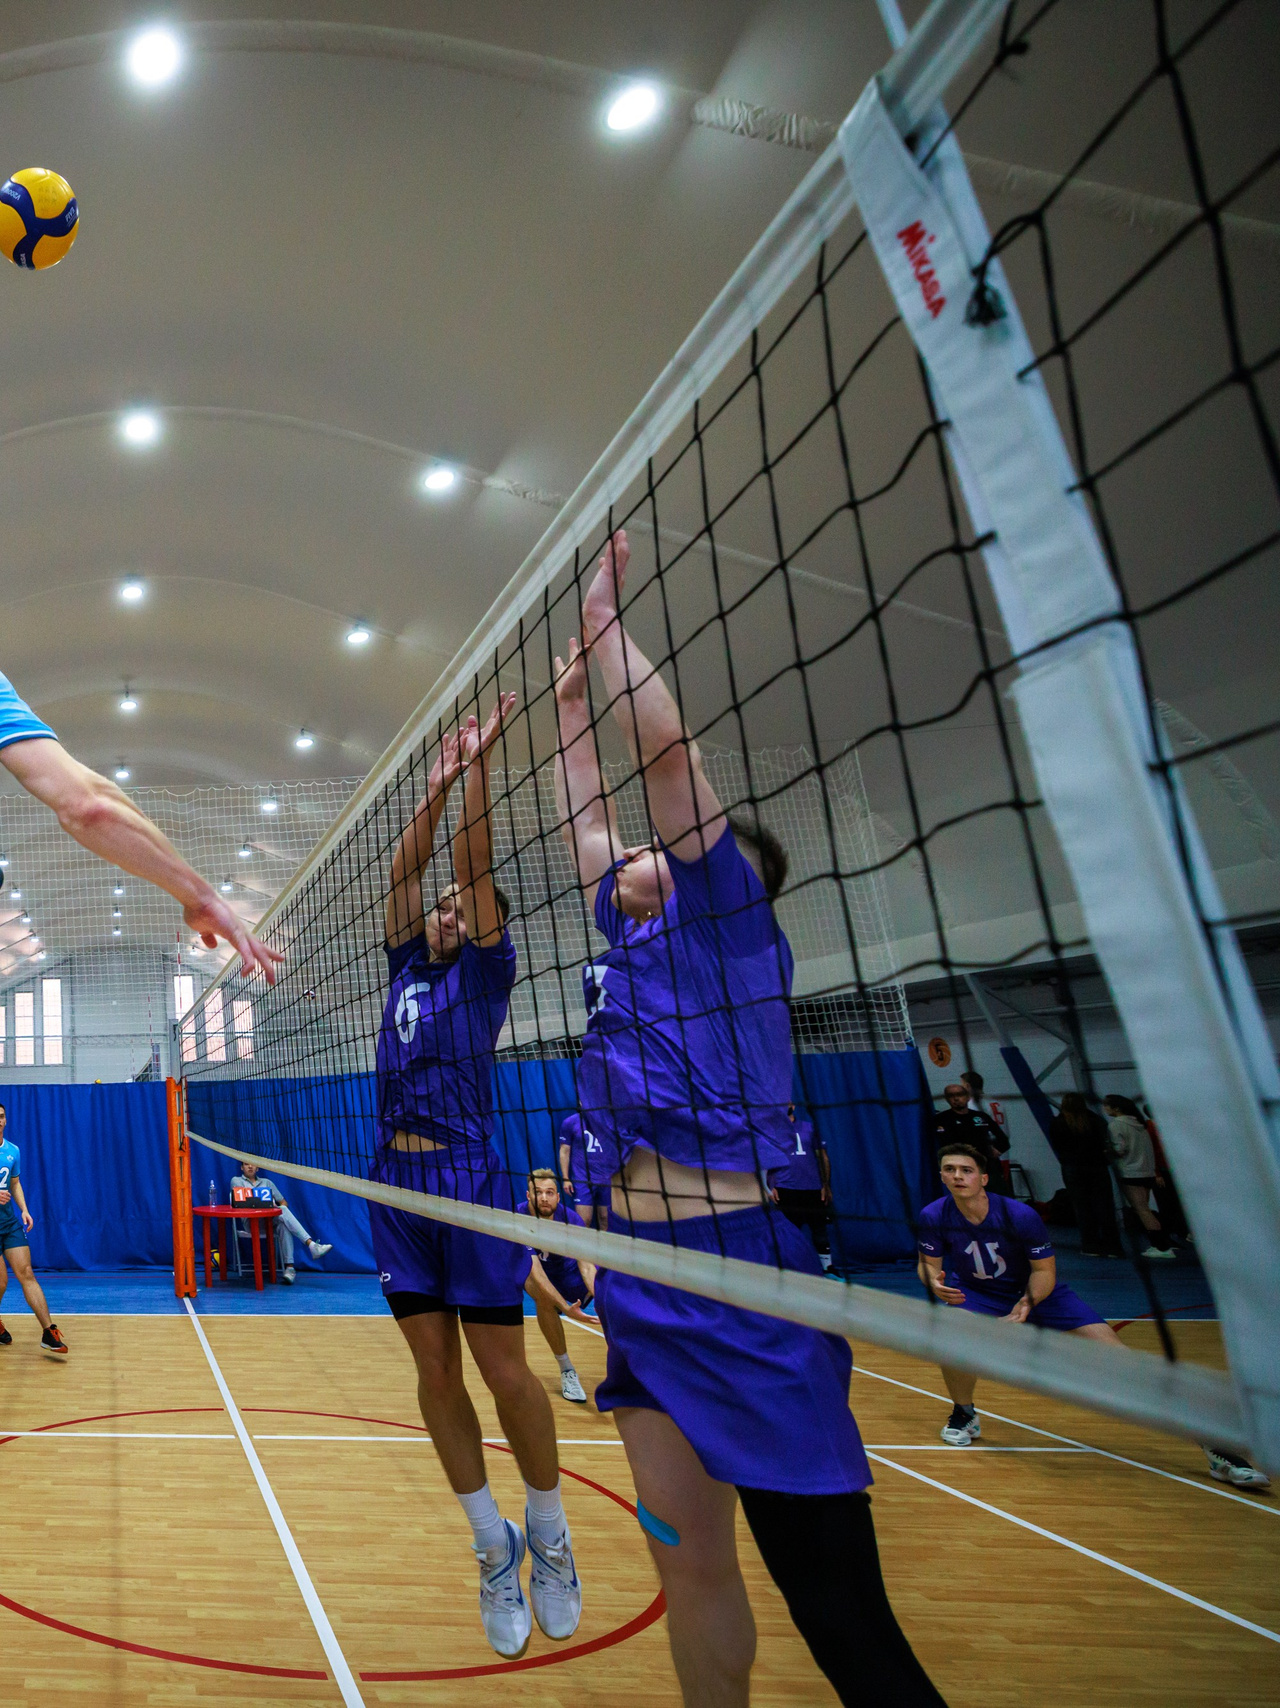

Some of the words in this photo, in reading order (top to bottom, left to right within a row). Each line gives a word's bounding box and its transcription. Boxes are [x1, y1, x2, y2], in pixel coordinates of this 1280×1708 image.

[395, 982, 431, 1044] 6
[261, 1189, 271, 1201] 2
[964, 1240, 1007, 1280] 15
